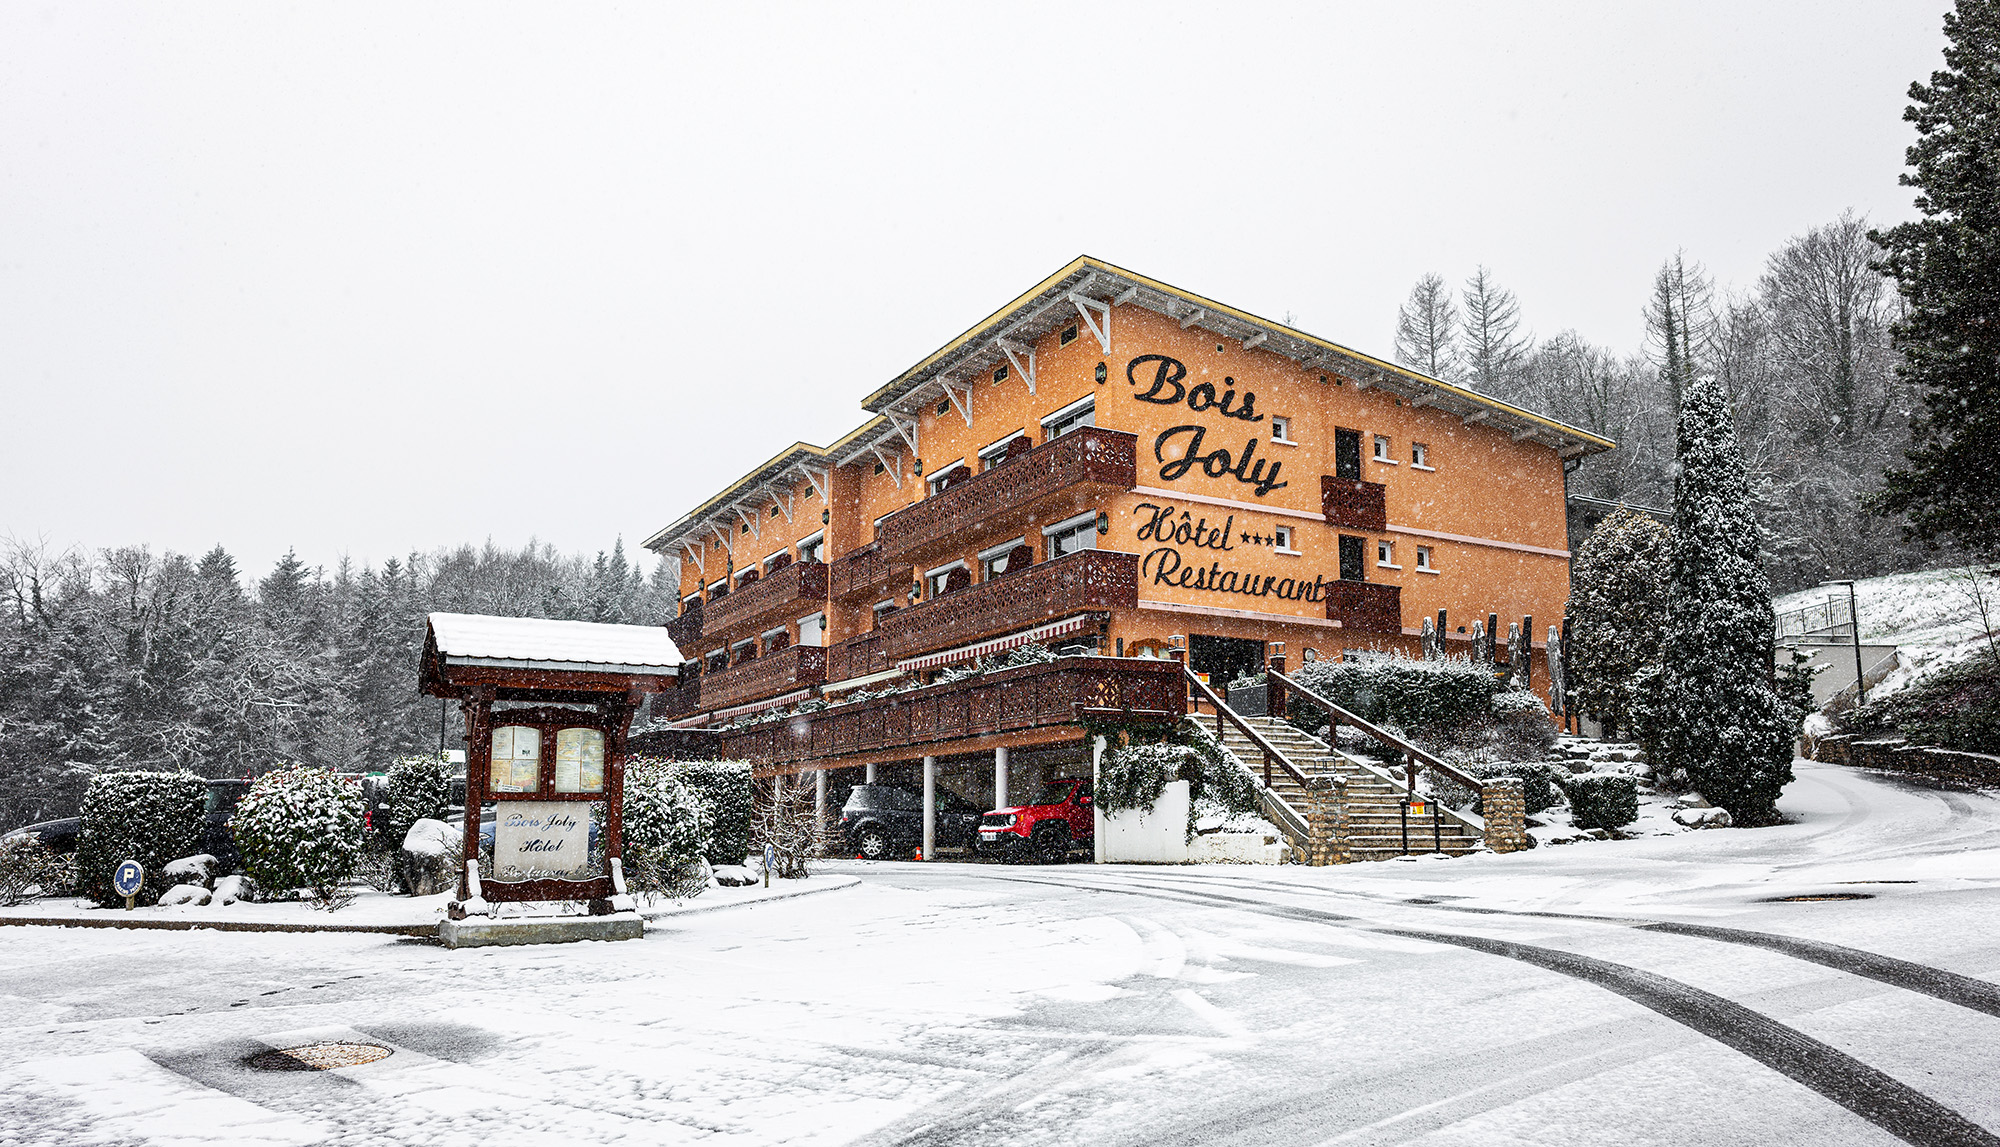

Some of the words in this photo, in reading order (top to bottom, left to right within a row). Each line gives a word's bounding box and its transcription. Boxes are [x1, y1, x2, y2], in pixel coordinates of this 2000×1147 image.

[1126, 354, 1264, 422] Bois
[1154, 425, 1288, 497] Joly
[1133, 503, 1234, 551] Hôtel
[1142, 547, 1326, 603] Restaurant
[505, 813, 541, 827] Bois
[541, 813, 578, 832] Joly
[519, 839, 564, 853] Hôtel
[123, 868, 134, 882] P
